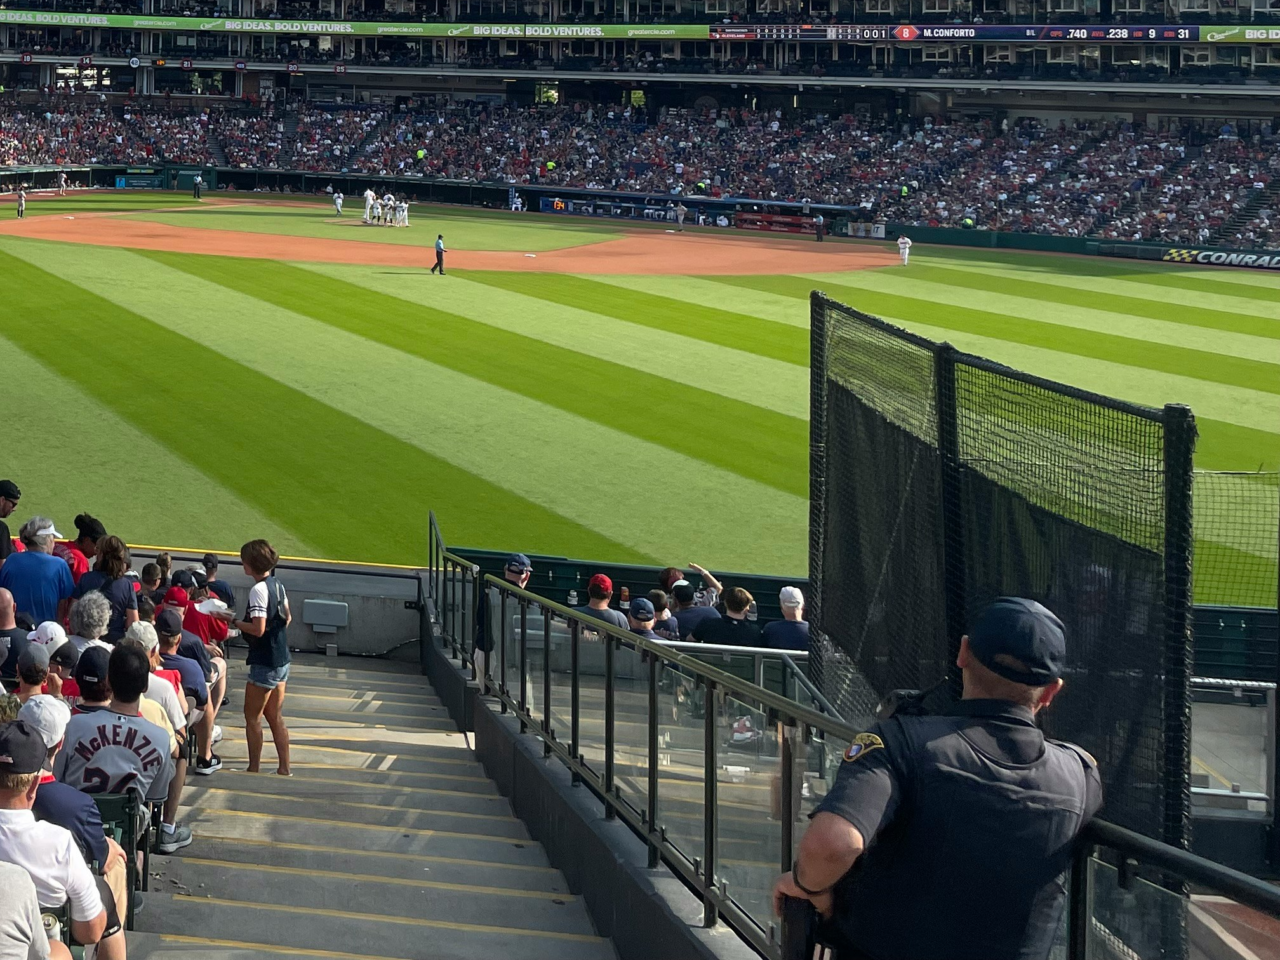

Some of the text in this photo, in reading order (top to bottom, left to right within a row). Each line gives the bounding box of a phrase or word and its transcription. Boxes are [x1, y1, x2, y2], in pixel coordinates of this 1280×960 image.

[6, 13, 35, 22] IDEAS.
[36, 14, 57, 23] BOLD
[57, 15, 110, 25] VENTURES.
[225, 21, 241, 29] BIG
[242, 21, 273, 31] IDEAS.
[274, 22, 300, 31] BOLD
[301, 22, 354, 32] VENTURES.
[473, 26, 489, 35] BIG
[491, 26, 523, 35] IDEAS.
[525, 27, 550, 36] BOLD
[550, 27, 604, 36] VENTURES.
[902, 28, 909, 38] 8
[1066, 29, 1087, 38] .740
[1106, 29, 1128, 38] .238
[1148, 29, 1155, 38] 9
[1178, 29, 1189, 38] 31
[1245, 29, 1267, 38] BIG
[1196, 251, 1280, 268] CONRAD
